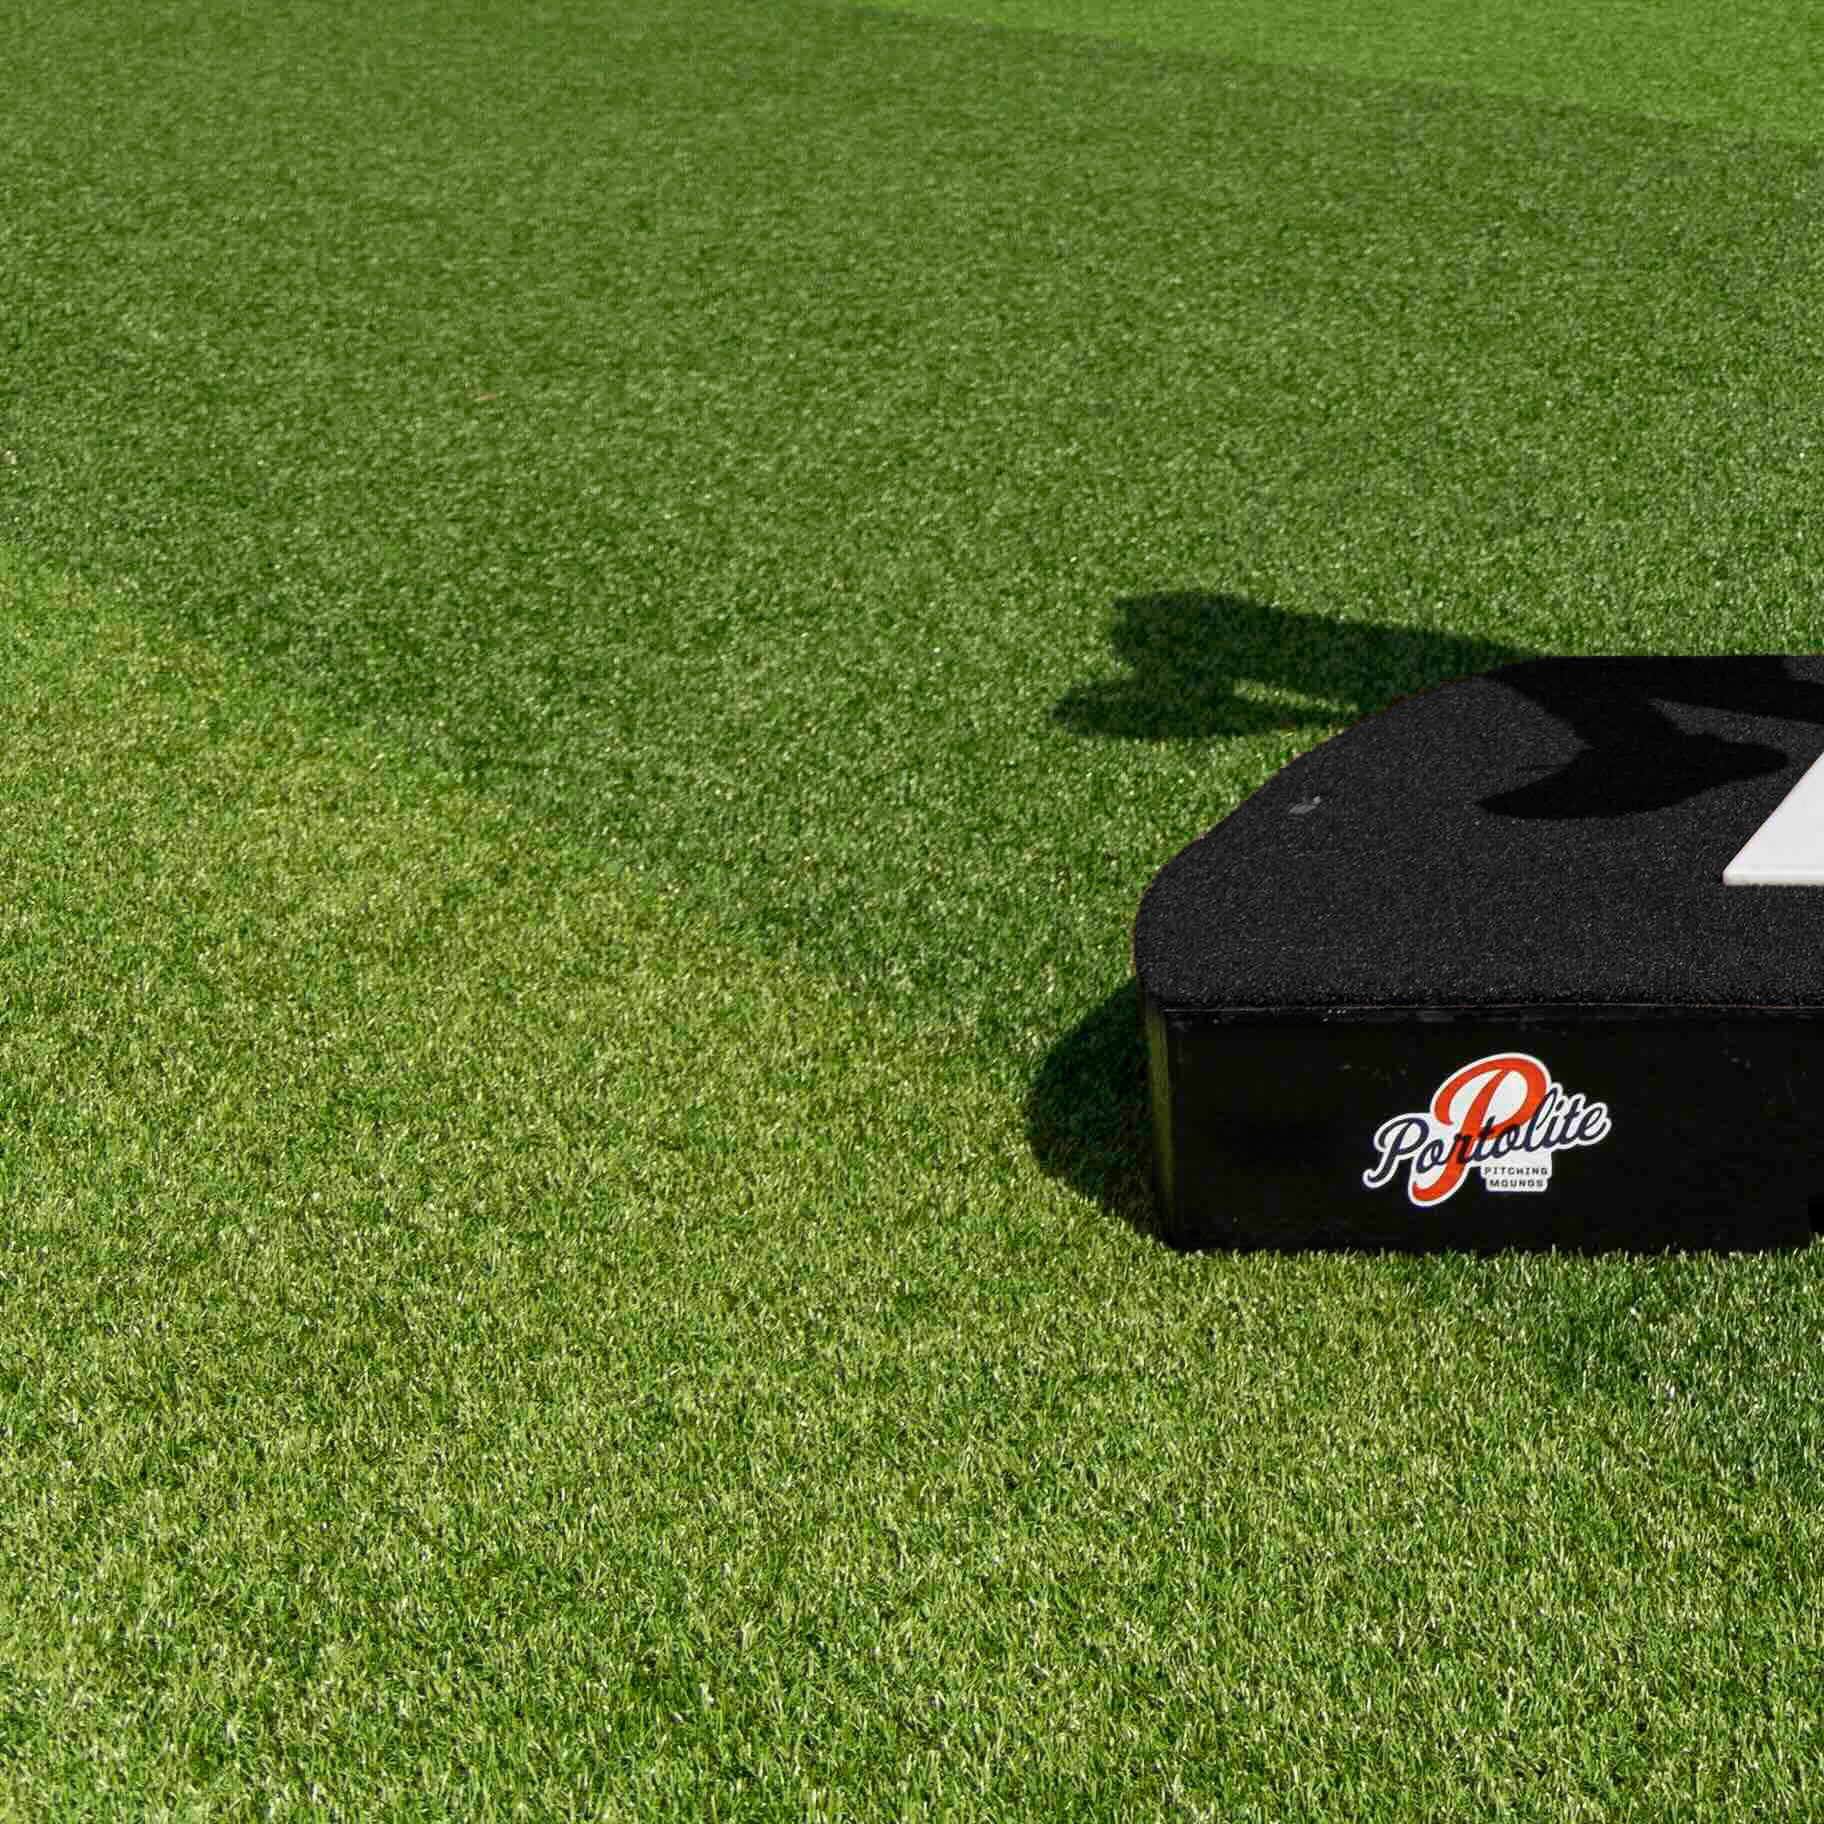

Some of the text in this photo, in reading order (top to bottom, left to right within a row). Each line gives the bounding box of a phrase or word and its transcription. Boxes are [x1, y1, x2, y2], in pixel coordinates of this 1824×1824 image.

[1366, 1086, 1609, 1184] Portolite
[1484, 1166, 1548, 1176] PITCHING
[1489, 1178, 1544, 1188] MOUNDS
